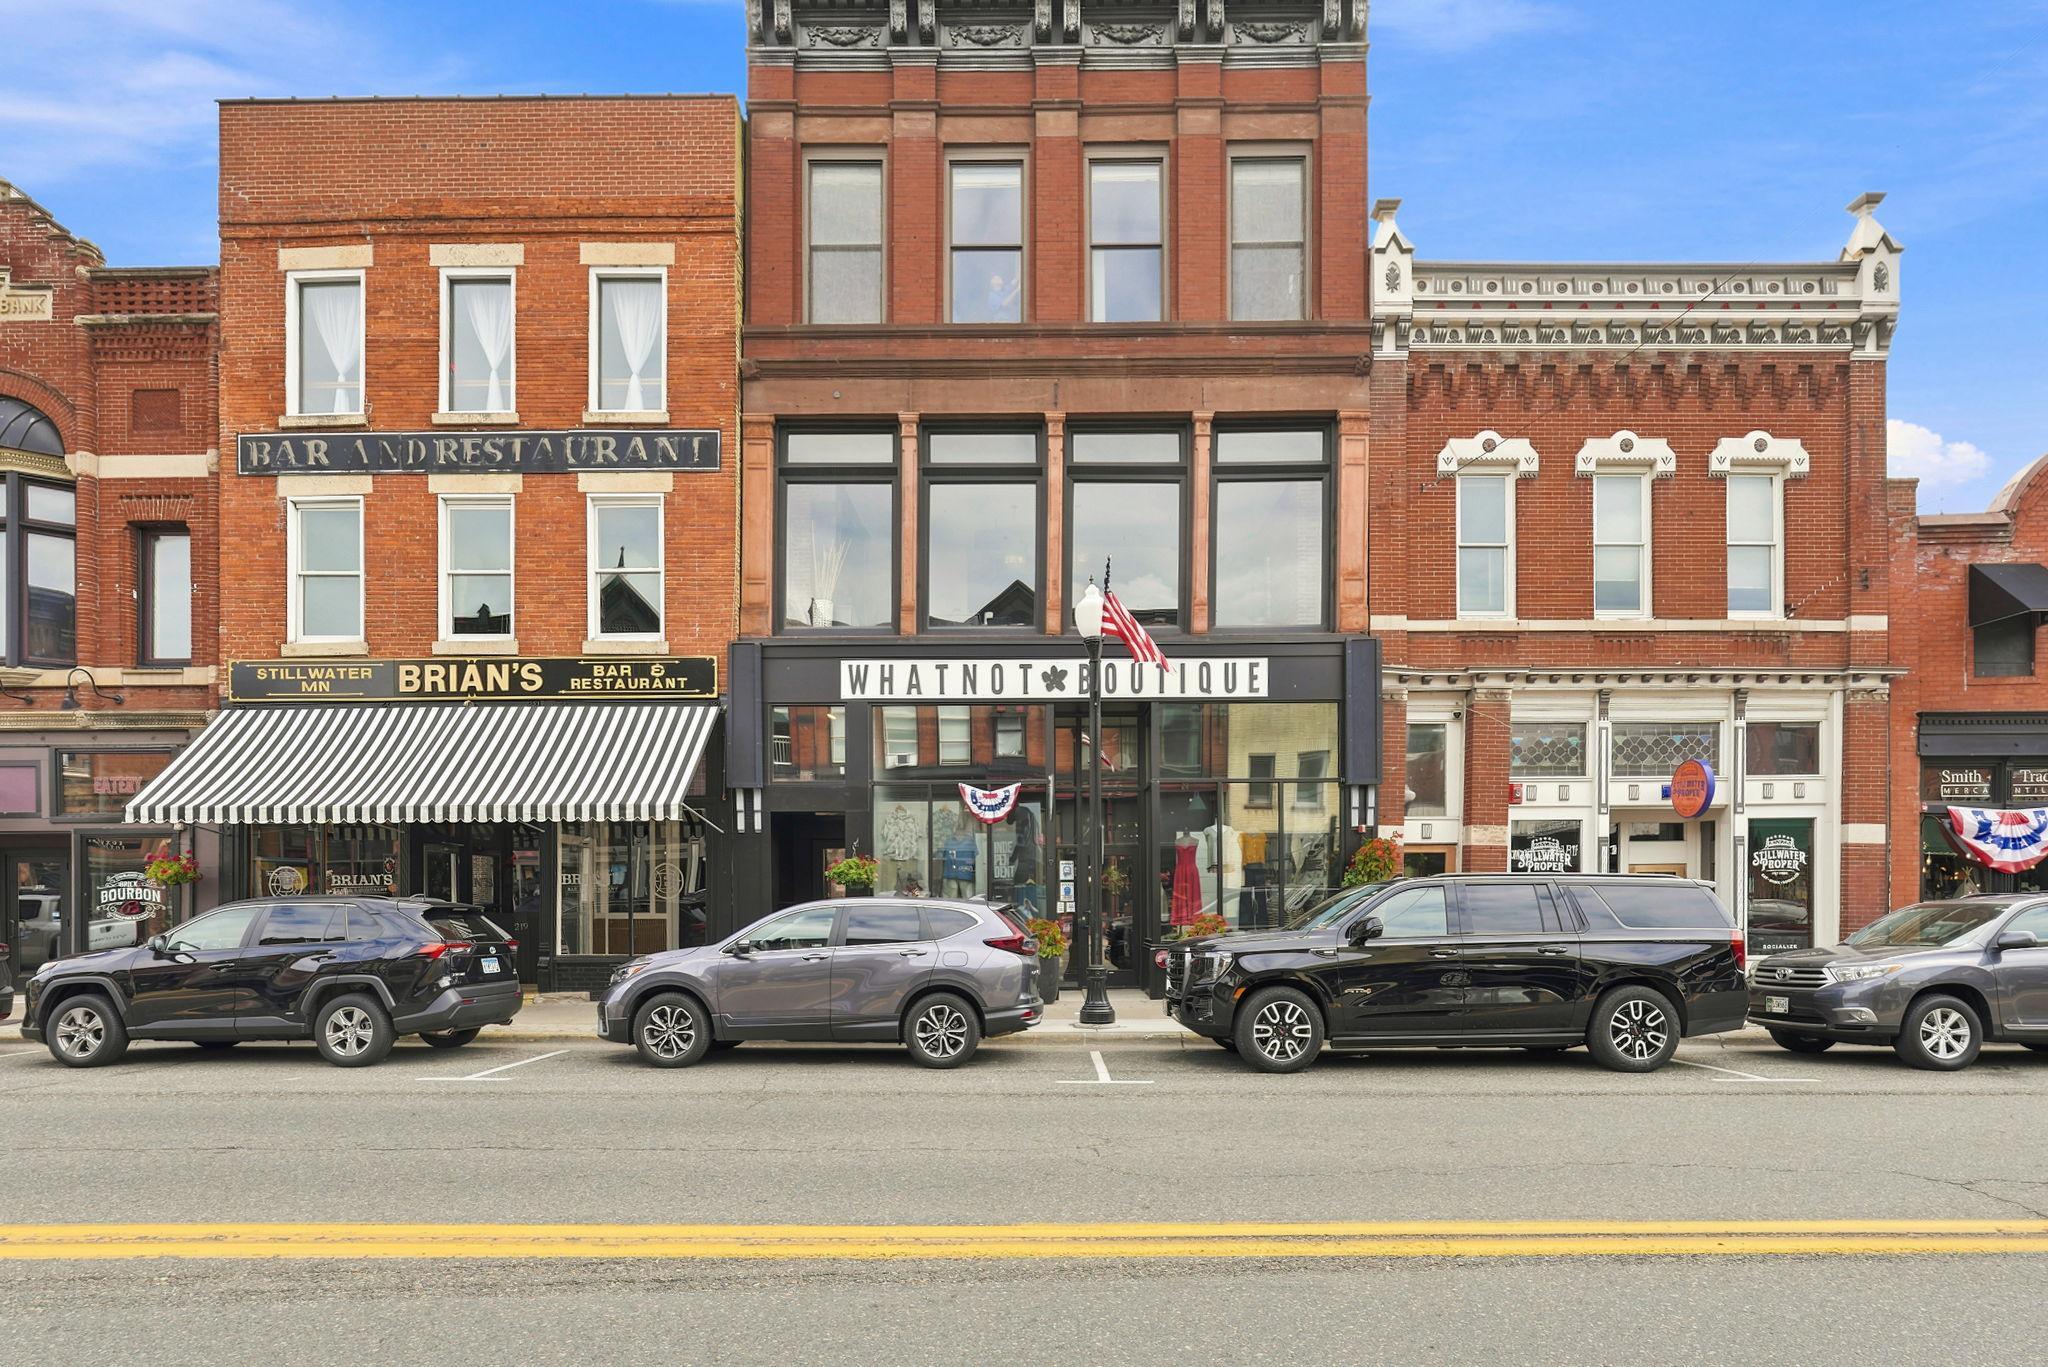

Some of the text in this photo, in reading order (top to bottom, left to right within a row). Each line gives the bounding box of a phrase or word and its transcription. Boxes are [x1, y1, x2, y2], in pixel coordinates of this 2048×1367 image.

[0, 299, 46, 314] BANK
[247, 439, 330, 467] BAR
[433, 435, 708, 467] RESTAURANT
[256, 667, 374, 681] STILLWATER
[398, 662, 544, 693] BRIAN'S
[593, 663, 666, 678] BAR &
[1078, 661, 1260, 695] BOUTIQUE
[301, 681, 331, 693] MN
[570, 677, 689, 690] RESTAURANT
[848, 663, 1033, 696] WHATNOT
[1941, 769, 1982, 783] Smith
[93, 776, 143, 795] EATERY
[1942, 786, 1990, 795] MERCA
[1518, 848, 1572, 868] STILLWATER
[1752, 850, 1807, 866] STILLWATER
[1761, 859, 1800, 871] PROPER
[1527, 861, 1565, 872] PROPER
[330, 873, 393, 887] BRIAN'S
[100, 887, 161, 904] BOURBON
[513, 922, 529, 932] 219
